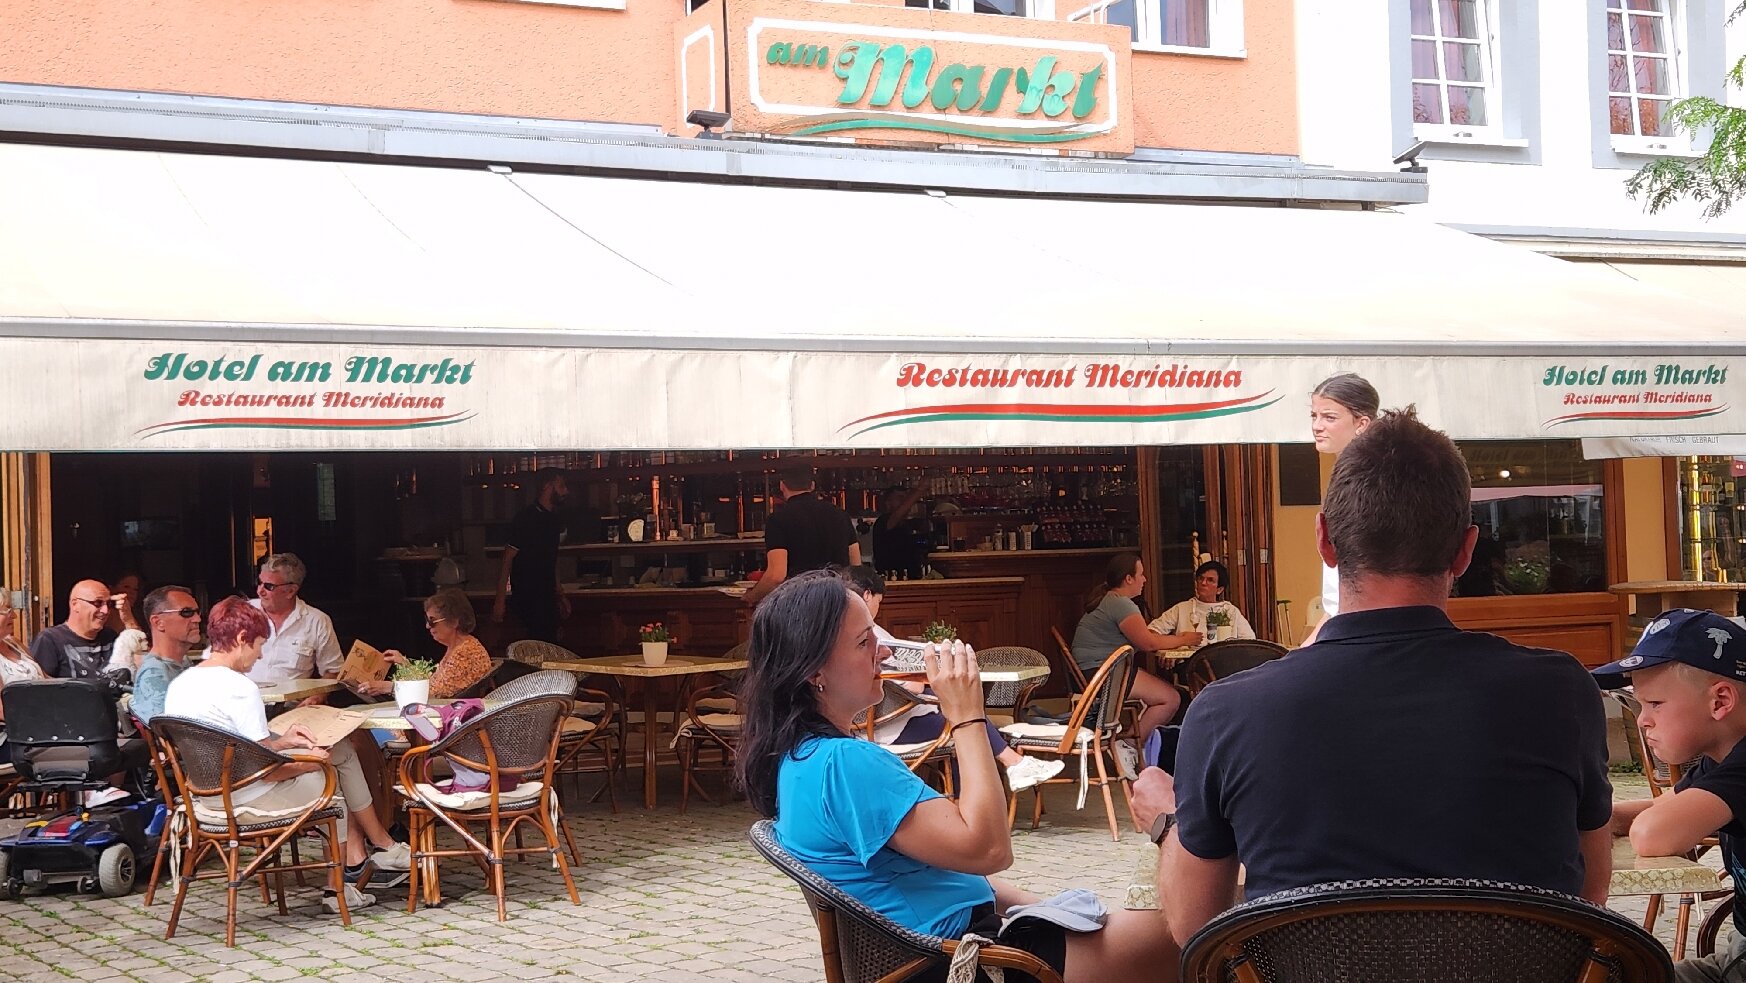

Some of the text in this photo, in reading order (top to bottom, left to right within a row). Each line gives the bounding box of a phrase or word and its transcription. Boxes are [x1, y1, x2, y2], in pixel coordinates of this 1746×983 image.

[766, 40, 1105, 119] am Markt
[143, 352, 476, 385] Hotel am Markt
[897, 362, 1242, 388] Restaurant Meridiana
[1542, 364, 1728, 386] Hotel am Markt
[177, 389, 445, 409] Restaurant Meridiana
[1563, 391, 1712, 405] Restaurant Meridiana
